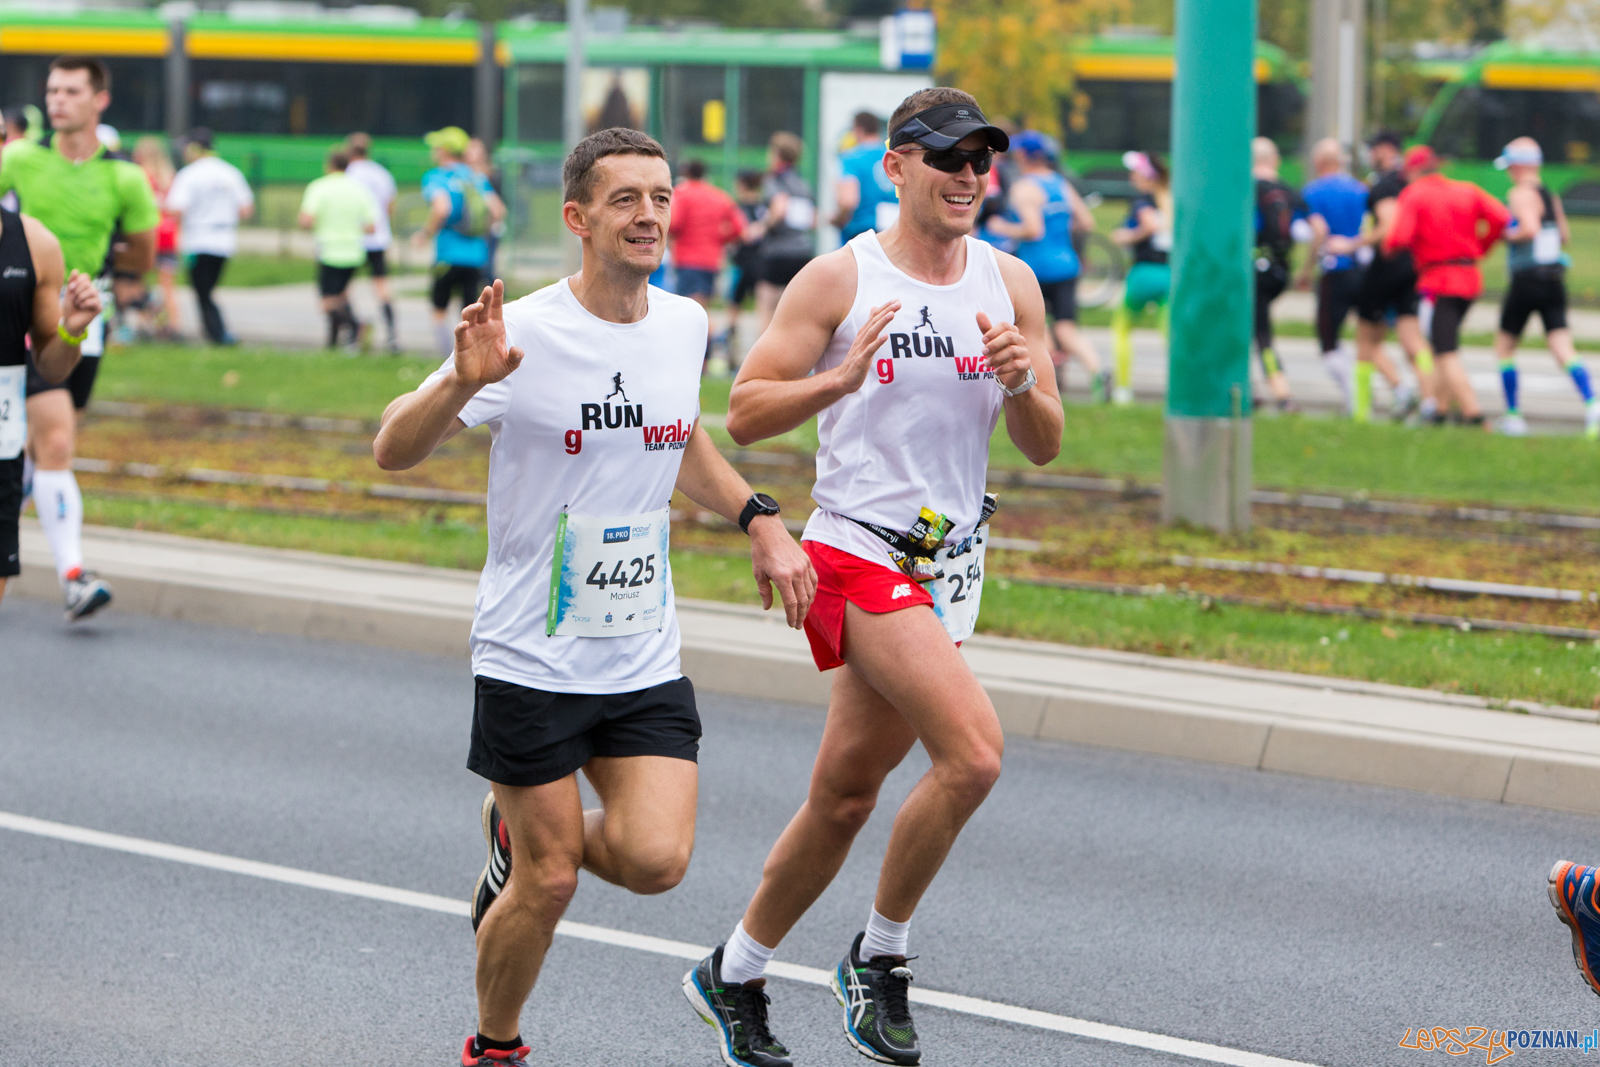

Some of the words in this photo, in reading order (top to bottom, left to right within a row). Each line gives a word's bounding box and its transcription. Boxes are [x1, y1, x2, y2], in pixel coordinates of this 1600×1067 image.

[876, 358, 895, 384] g
[890, 332, 955, 358] RUN
[954, 355, 995, 373] wa
[958, 372, 980, 381] TEAM
[0, 398, 9, 421] 2
[564, 429, 582, 455] g
[581, 402, 643, 430] RUN
[645, 443, 665, 451] TEAM
[615, 530, 629, 539] PKO
[586, 553, 655, 590] 4425
[610, 591, 640, 601] Mariusz
